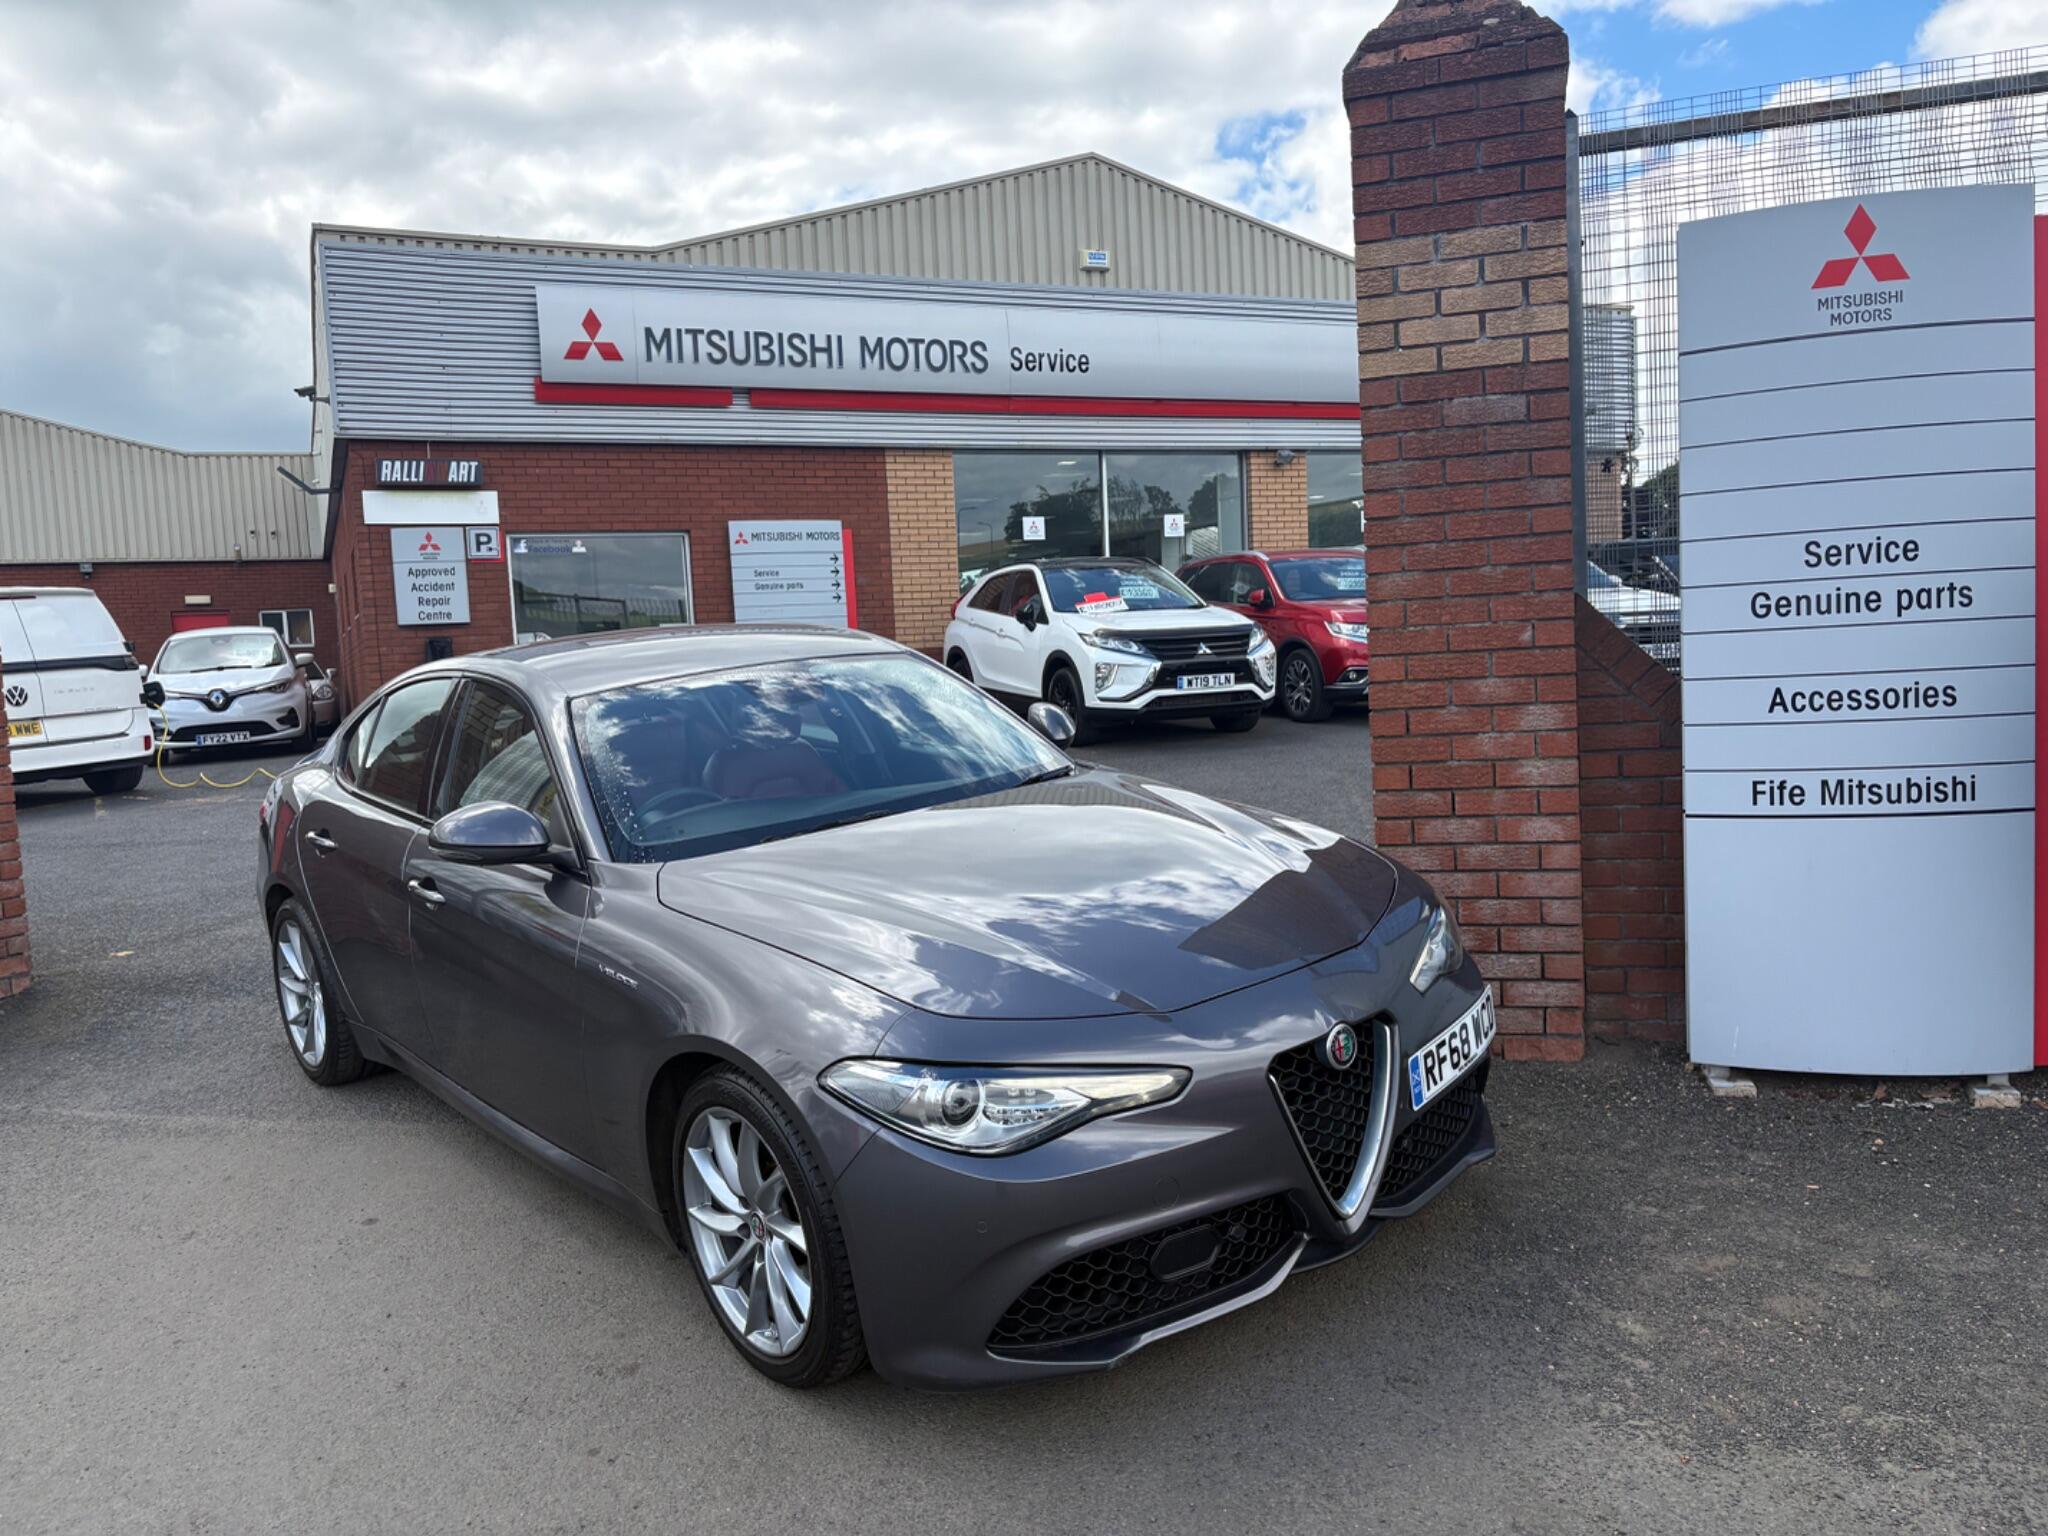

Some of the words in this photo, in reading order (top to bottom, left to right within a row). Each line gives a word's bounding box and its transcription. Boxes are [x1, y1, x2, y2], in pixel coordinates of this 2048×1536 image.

[1817, 290, 1903, 311] MITSUBISHI
[1830, 308, 1893, 326] MOTORS
[643, 326, 844, 369] MITSUBISHI
[859, 336, 989, 374] MOTORS
[1009, 346, 1090, 374] Service
[448, 461, 478, 482] ART
[474, 532, 492, 552] P
[751, 531, 802, 541] MITSUBISHI
[805, 531, 840, 541] MOTORS
[1803, 536, 1919, 568] Service
[408, 566, 456, 579] Approved
[754, 569, 780, 578] Service
[411, 582, 455, 593] Accident
[754, 582, 784, 591] Genuine
[786, 582, 804, 591] parts
[418, 596, 451, 608] Repair
[1750, 586, 1882, 619] Genuine
[1897, 582, 1973, 617] parts
[418, 610, 452, 621] Centre
[1186, 675, 1210, 688] WT19
[1211, 673, 1232, 686] TLN
[1768, 681, 1958, 714] Accessories
[1751, 780, 1805, 806] Fife
[1820, 774, 1976, 806] Mitsubishi
[1423, 1022, 1471, 1091] RF68
